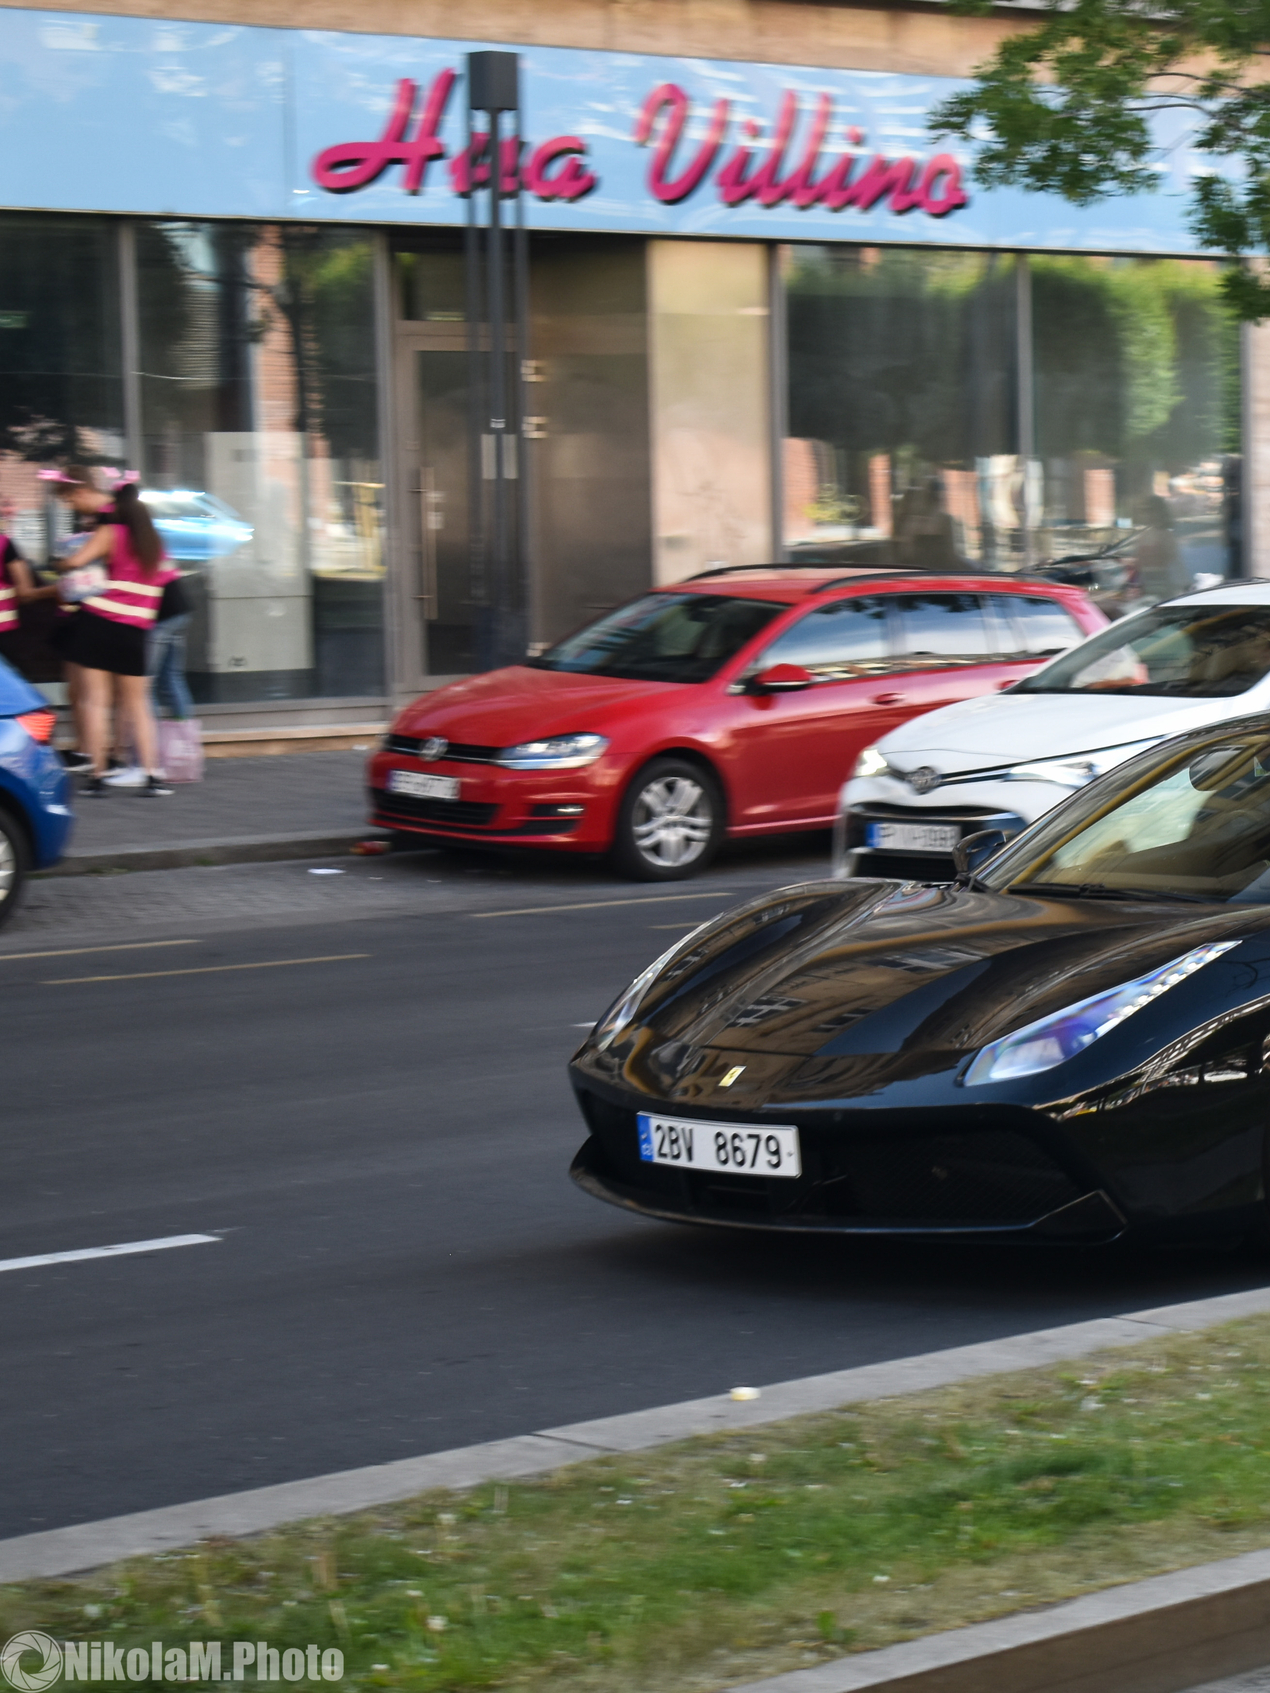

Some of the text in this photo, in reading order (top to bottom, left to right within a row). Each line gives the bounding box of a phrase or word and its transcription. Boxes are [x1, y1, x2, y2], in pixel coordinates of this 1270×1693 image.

[633, 83, 969, 218] Villino
[655, 1123, 782, 1169] 2BV 8679
